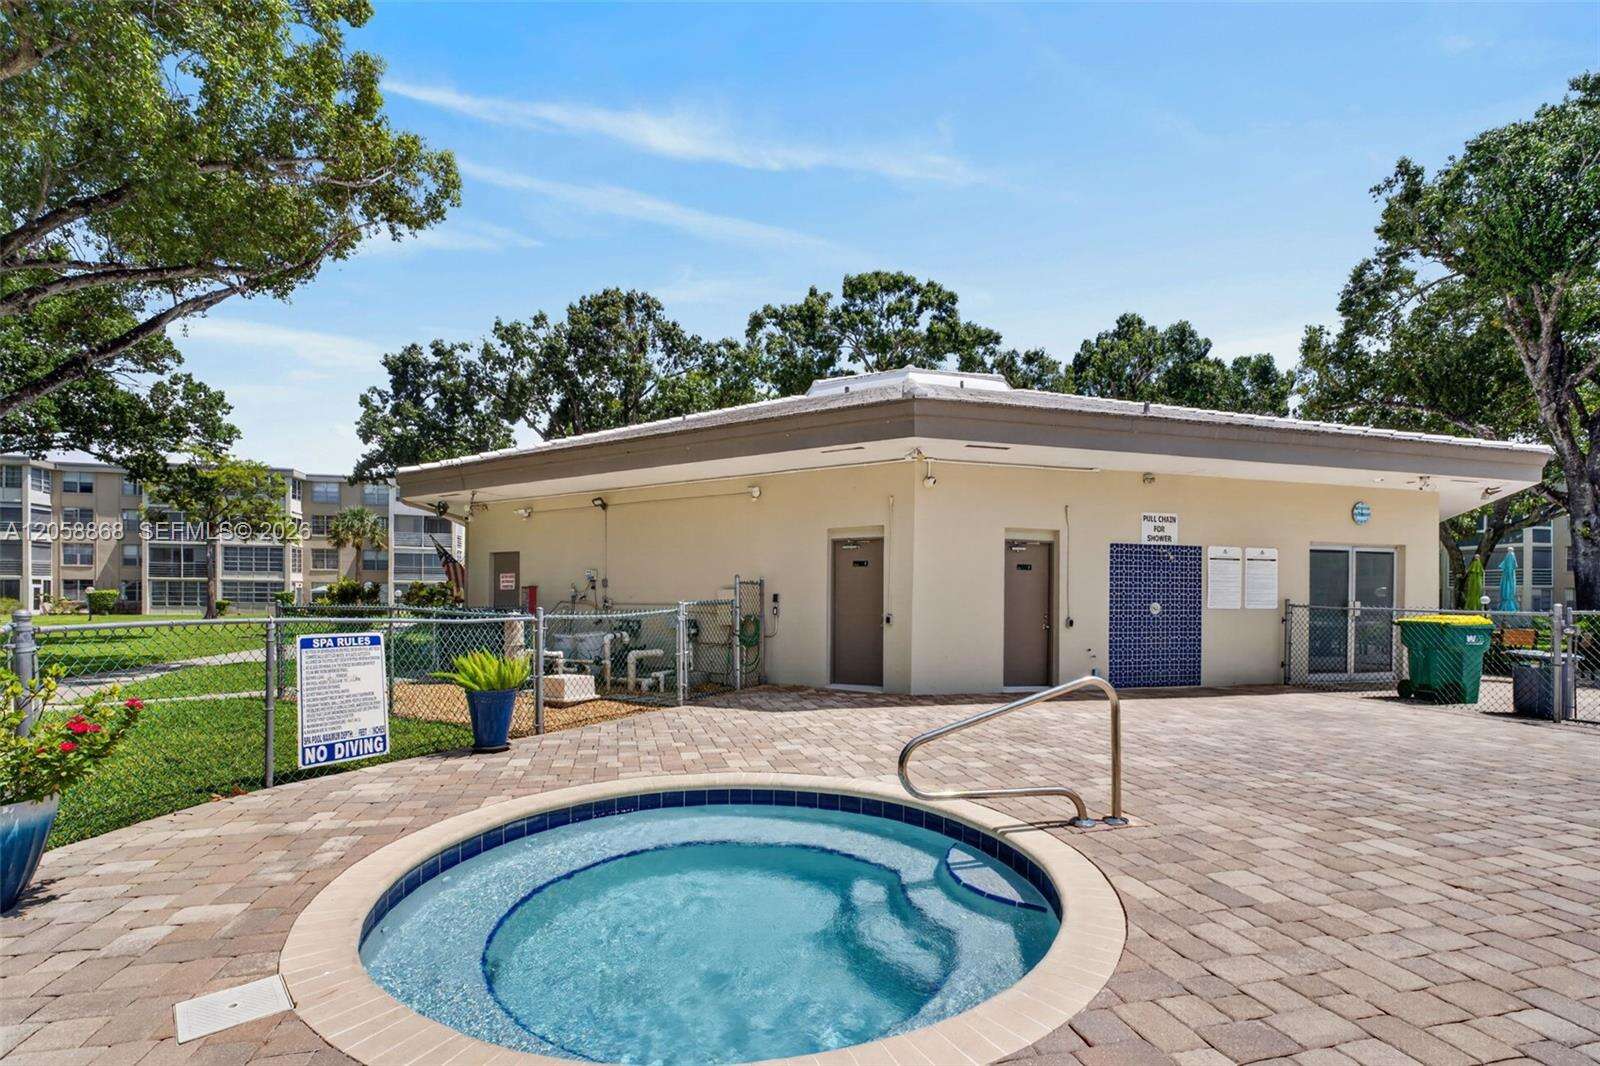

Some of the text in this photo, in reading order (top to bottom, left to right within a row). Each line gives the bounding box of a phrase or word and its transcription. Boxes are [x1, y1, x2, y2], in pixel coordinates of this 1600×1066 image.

[1143, 515, 1157, 523] PULL
[312, 637, 371, 647] SPA RULES
[304, 737, 384, 764] NO DIVING
